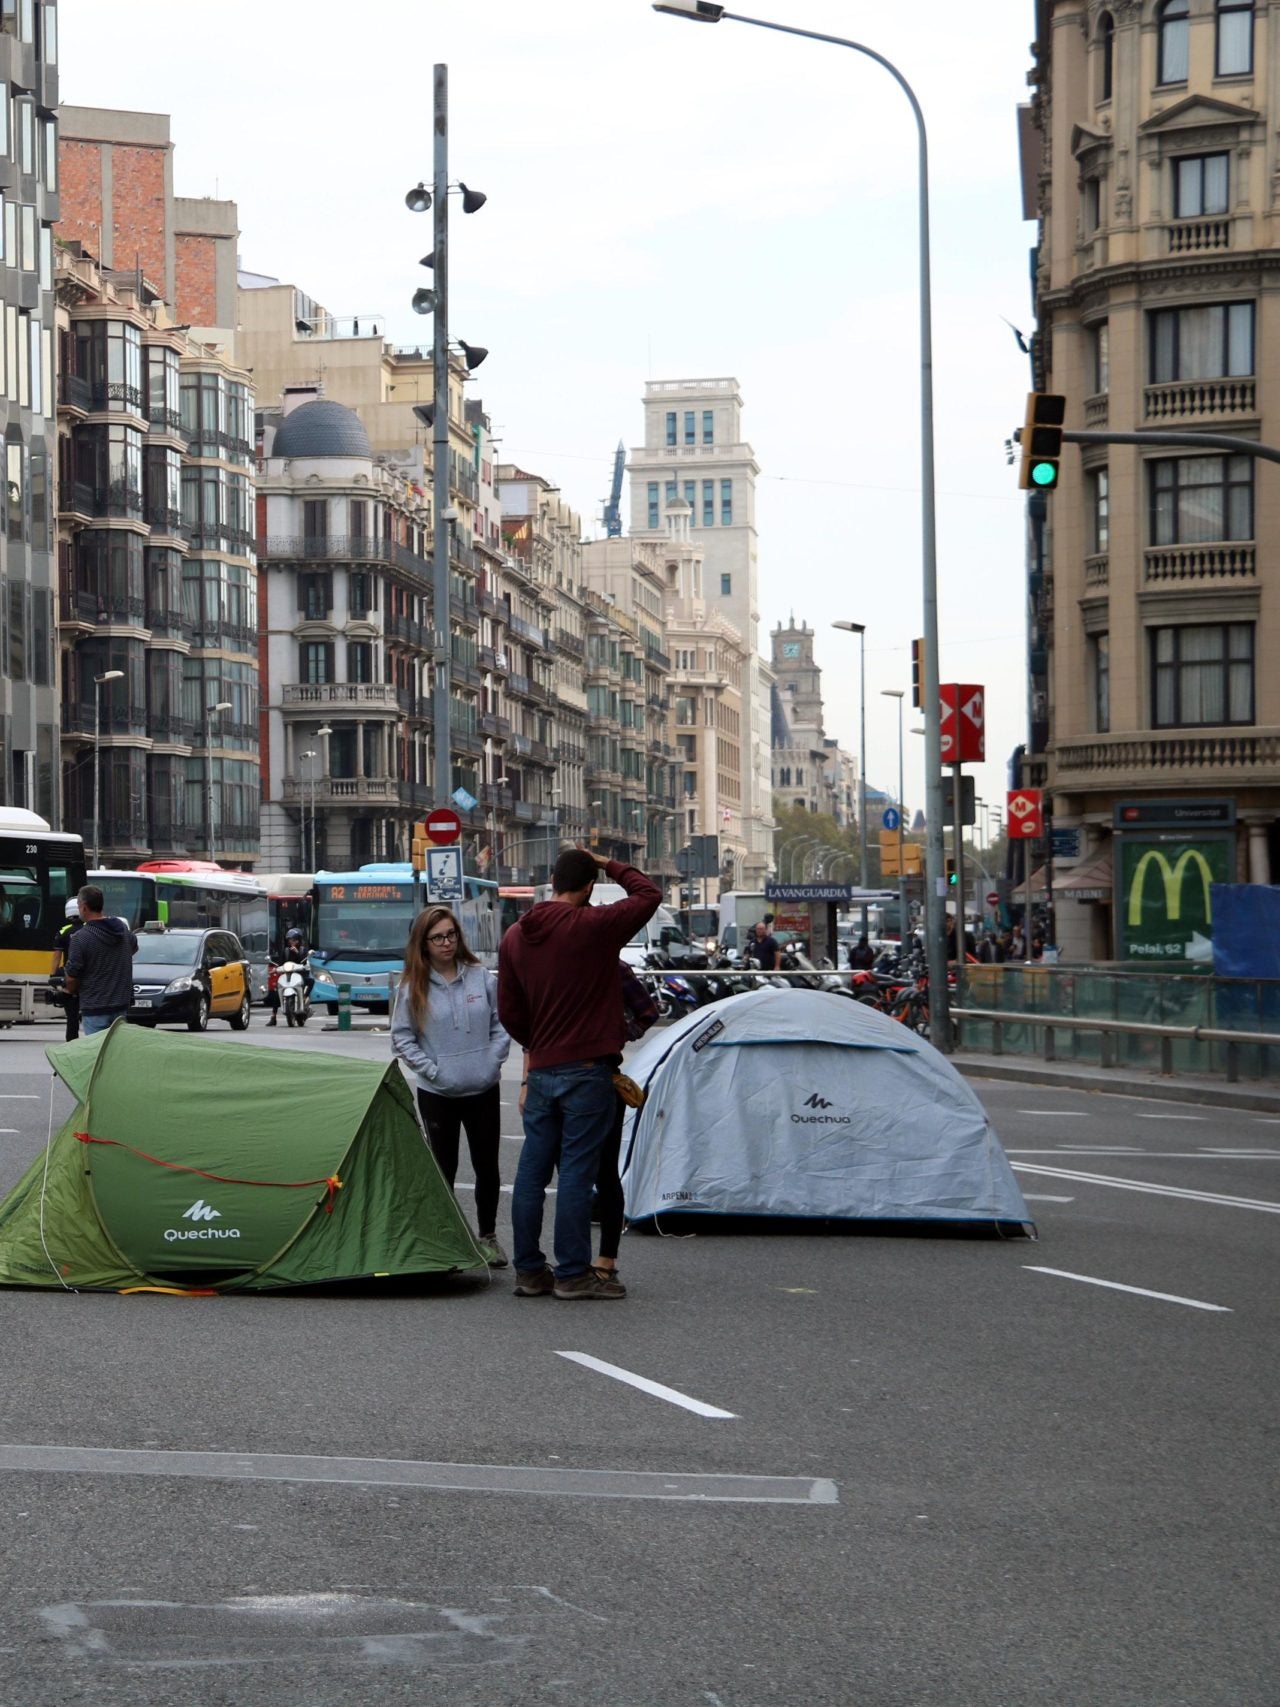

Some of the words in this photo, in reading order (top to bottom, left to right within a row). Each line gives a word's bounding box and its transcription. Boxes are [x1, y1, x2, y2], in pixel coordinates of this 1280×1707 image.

[1015, 802, 1026, 813] M
[25, 844, 38, 854] 230
[331, 886, 345, 899] A2
[768, 888, 781, 898] LA
[781, 888, 848, 898] VANGUARDIA
[1165, 943, 1182, 954] 62
[790, 1113, 851, 1124] Quechua
[163, 1228, 241, 1242] Quechua
